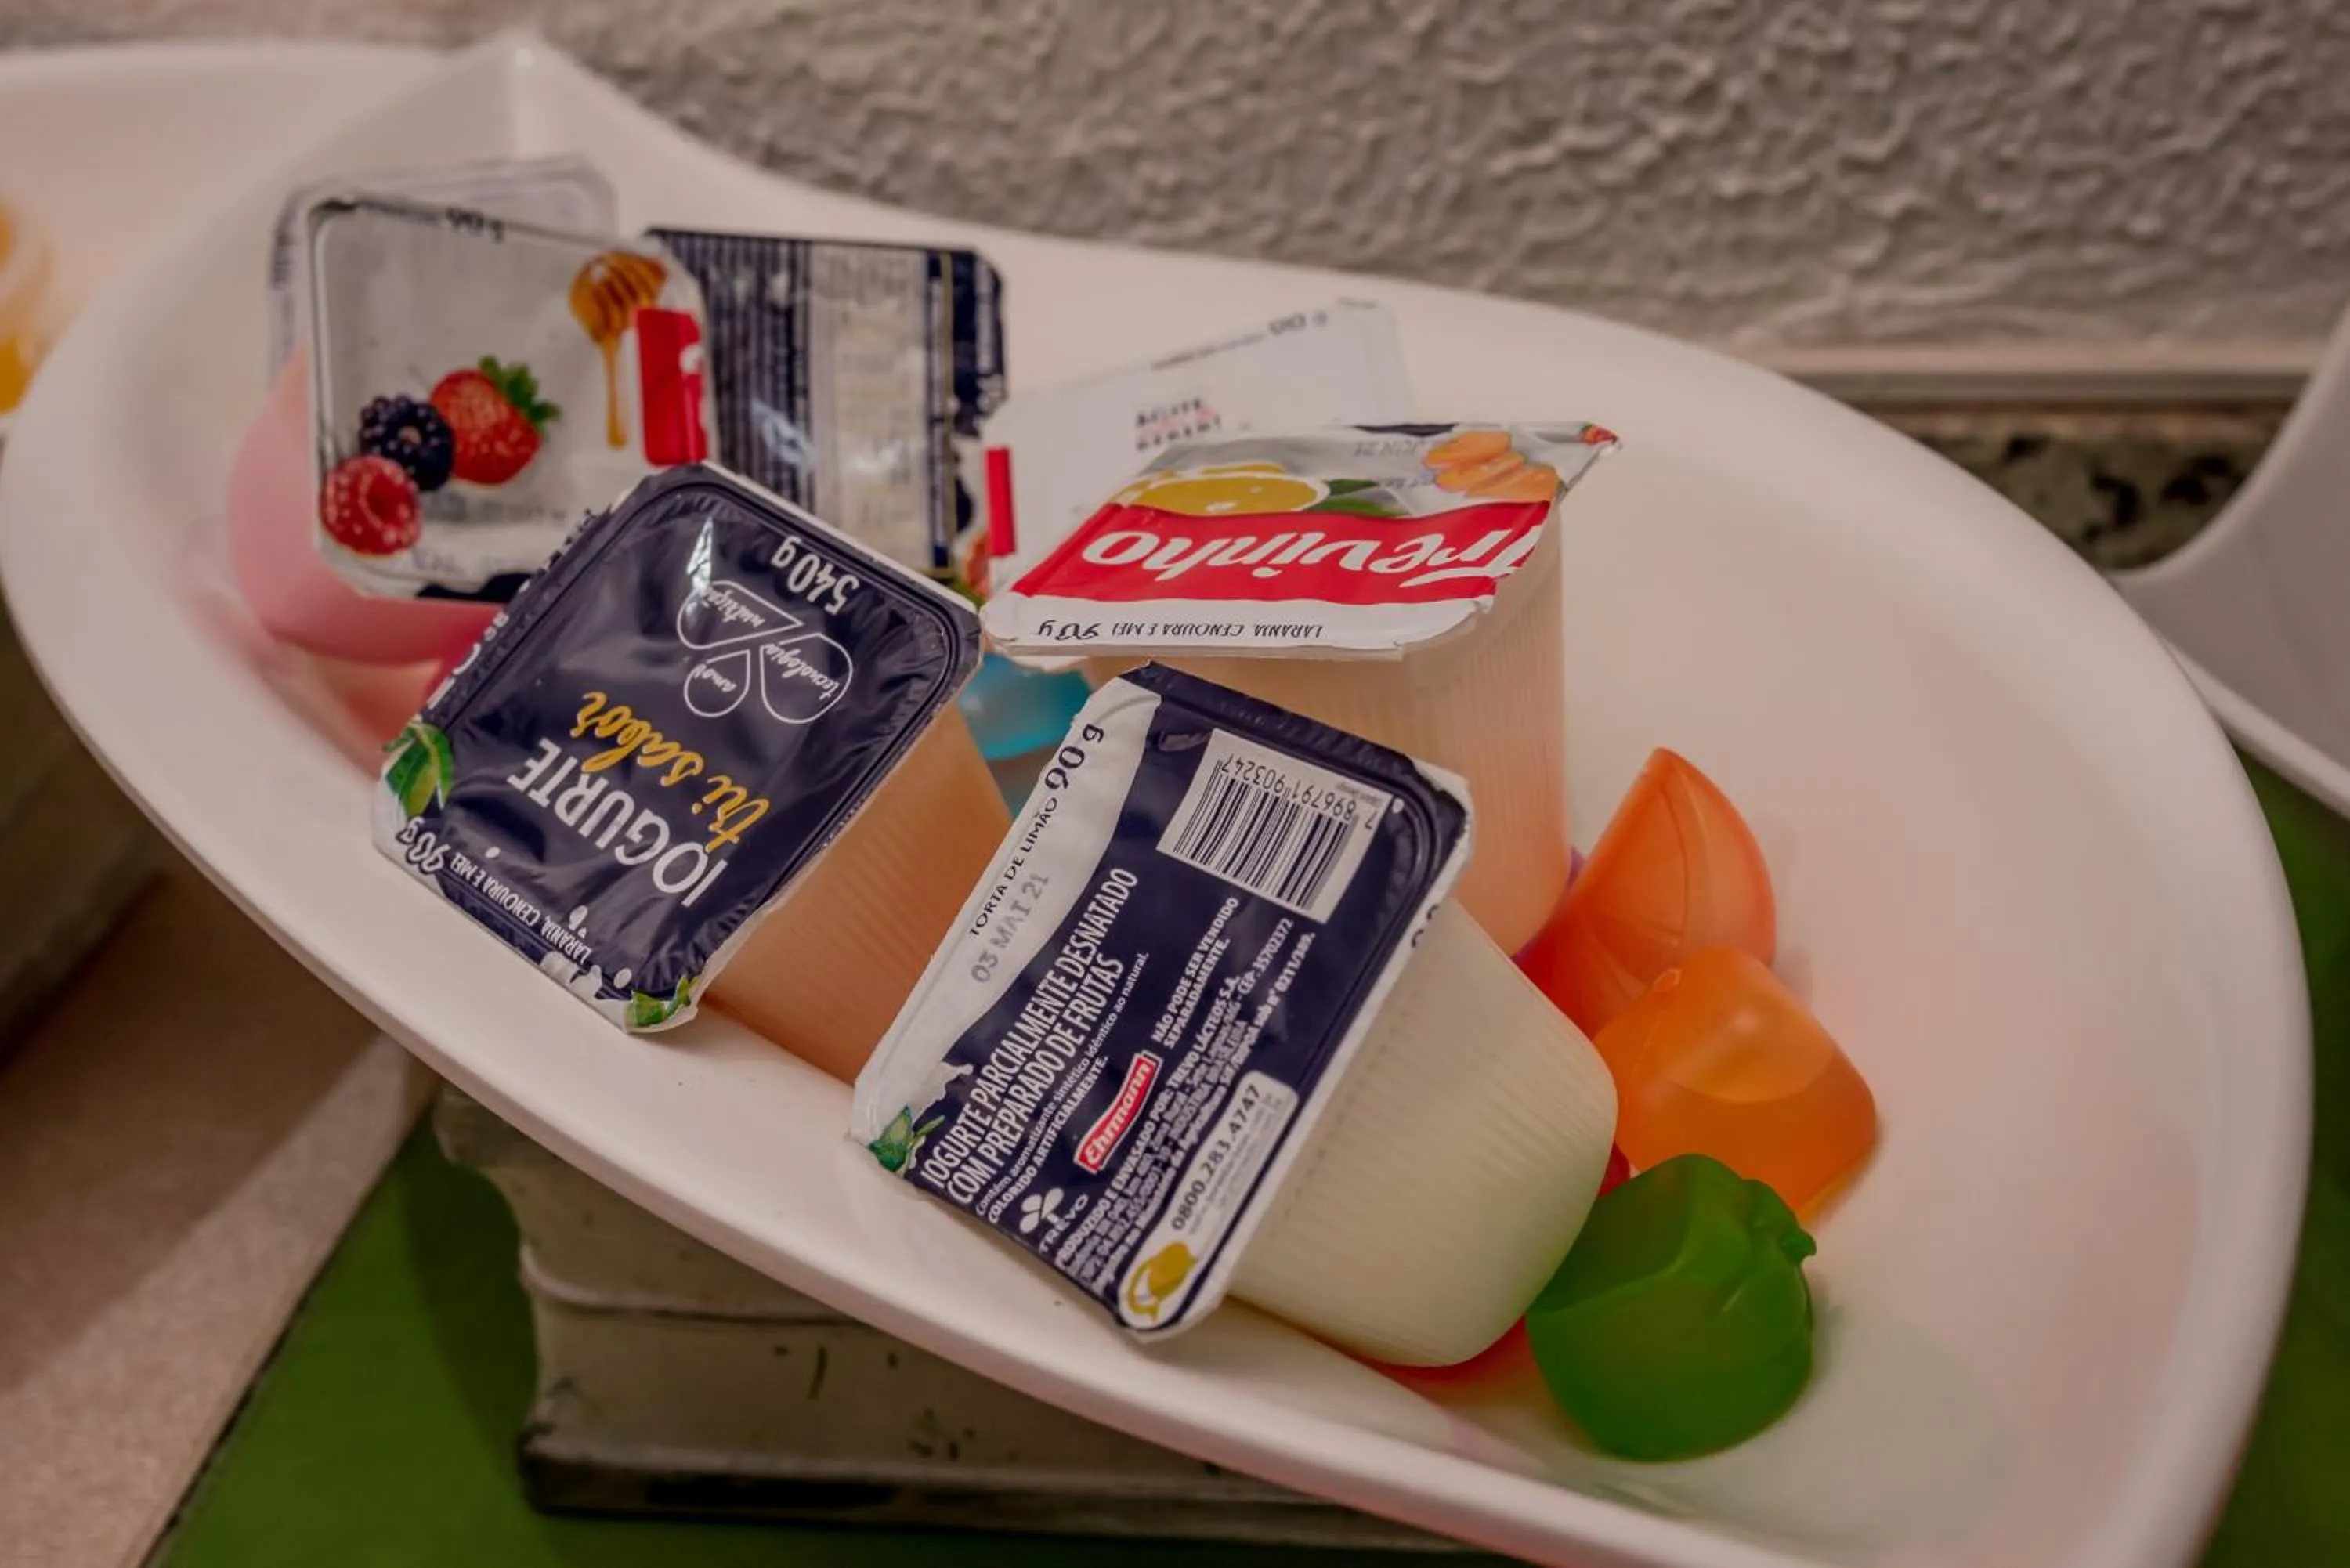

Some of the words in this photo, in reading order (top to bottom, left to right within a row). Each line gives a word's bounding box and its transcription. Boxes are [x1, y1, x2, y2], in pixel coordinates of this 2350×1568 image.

[771, 535, 801, 567] g
[787, 553, 859, 614] 540
[1084, 529, 1543, 588] Trevinho
[569, 691, 704, 786] sabor
[1220, 753, 1285, 793] 903247
[508, 740, 725, 905] IOGURTE
[691, 775, 770, 853] tri
[969, 885, 1007, 935] TORTA
[1003, 858, 1024, 880] DE
[1020, 797, 1058, 852] LIMÃO
[1044, 746, 1085, 789] 90
[1082, 724, 1104, 742] g
[1292, 780, 1356, 821] 896791
[408, 832, 450, 876] 90
[450, 851, 478, 879] MEL
[474, 869, 486, 884] E
[483, 876, 540, 925] CENOURA
[971, 950, 998, 982] 03
[989, 899, 1030, 948] MAI
[1021, 874, 1049, 899] 21
[1062, 953, 1123, 1030] FRUTAS
[1151, 1013, 1173, 1042] NÃO
[1166, 977, 1191, 1013] PODE
[1184, 952, 1204, 977] SER
[1197, 897, 1238, 951] VENDIDO
[1163, 938, 1230, 1047] SEPARADAMENTE.
[920, 1103, 991, 1187] IOGURTE
[971, 970, 1076, 1110] PARCIALMENTE
[1055, 869, 1137, 977] DESNATADO
[1044, 1022, 1084, 1057] DE
[1053, 1057, 1090, 1101] sintético
[1084, 1013, 1117, 1057] idêntico
[1113, 996, 1126, 1013] ao
[1121, 952, 1148, 996] natural.
[978, 1050, 1064, 1165] PREPARADO
[988, 1165, 1036, 1223] COLORIDO
[1033, 1057, 1108, 1165] ARTIFICIALMENTE.
[1085, 1064, 1150, 1164] Ehrmann
[947, 1156, 996, 1203] COM
[1112, 1121, 1155, 1190] ENVASADO
